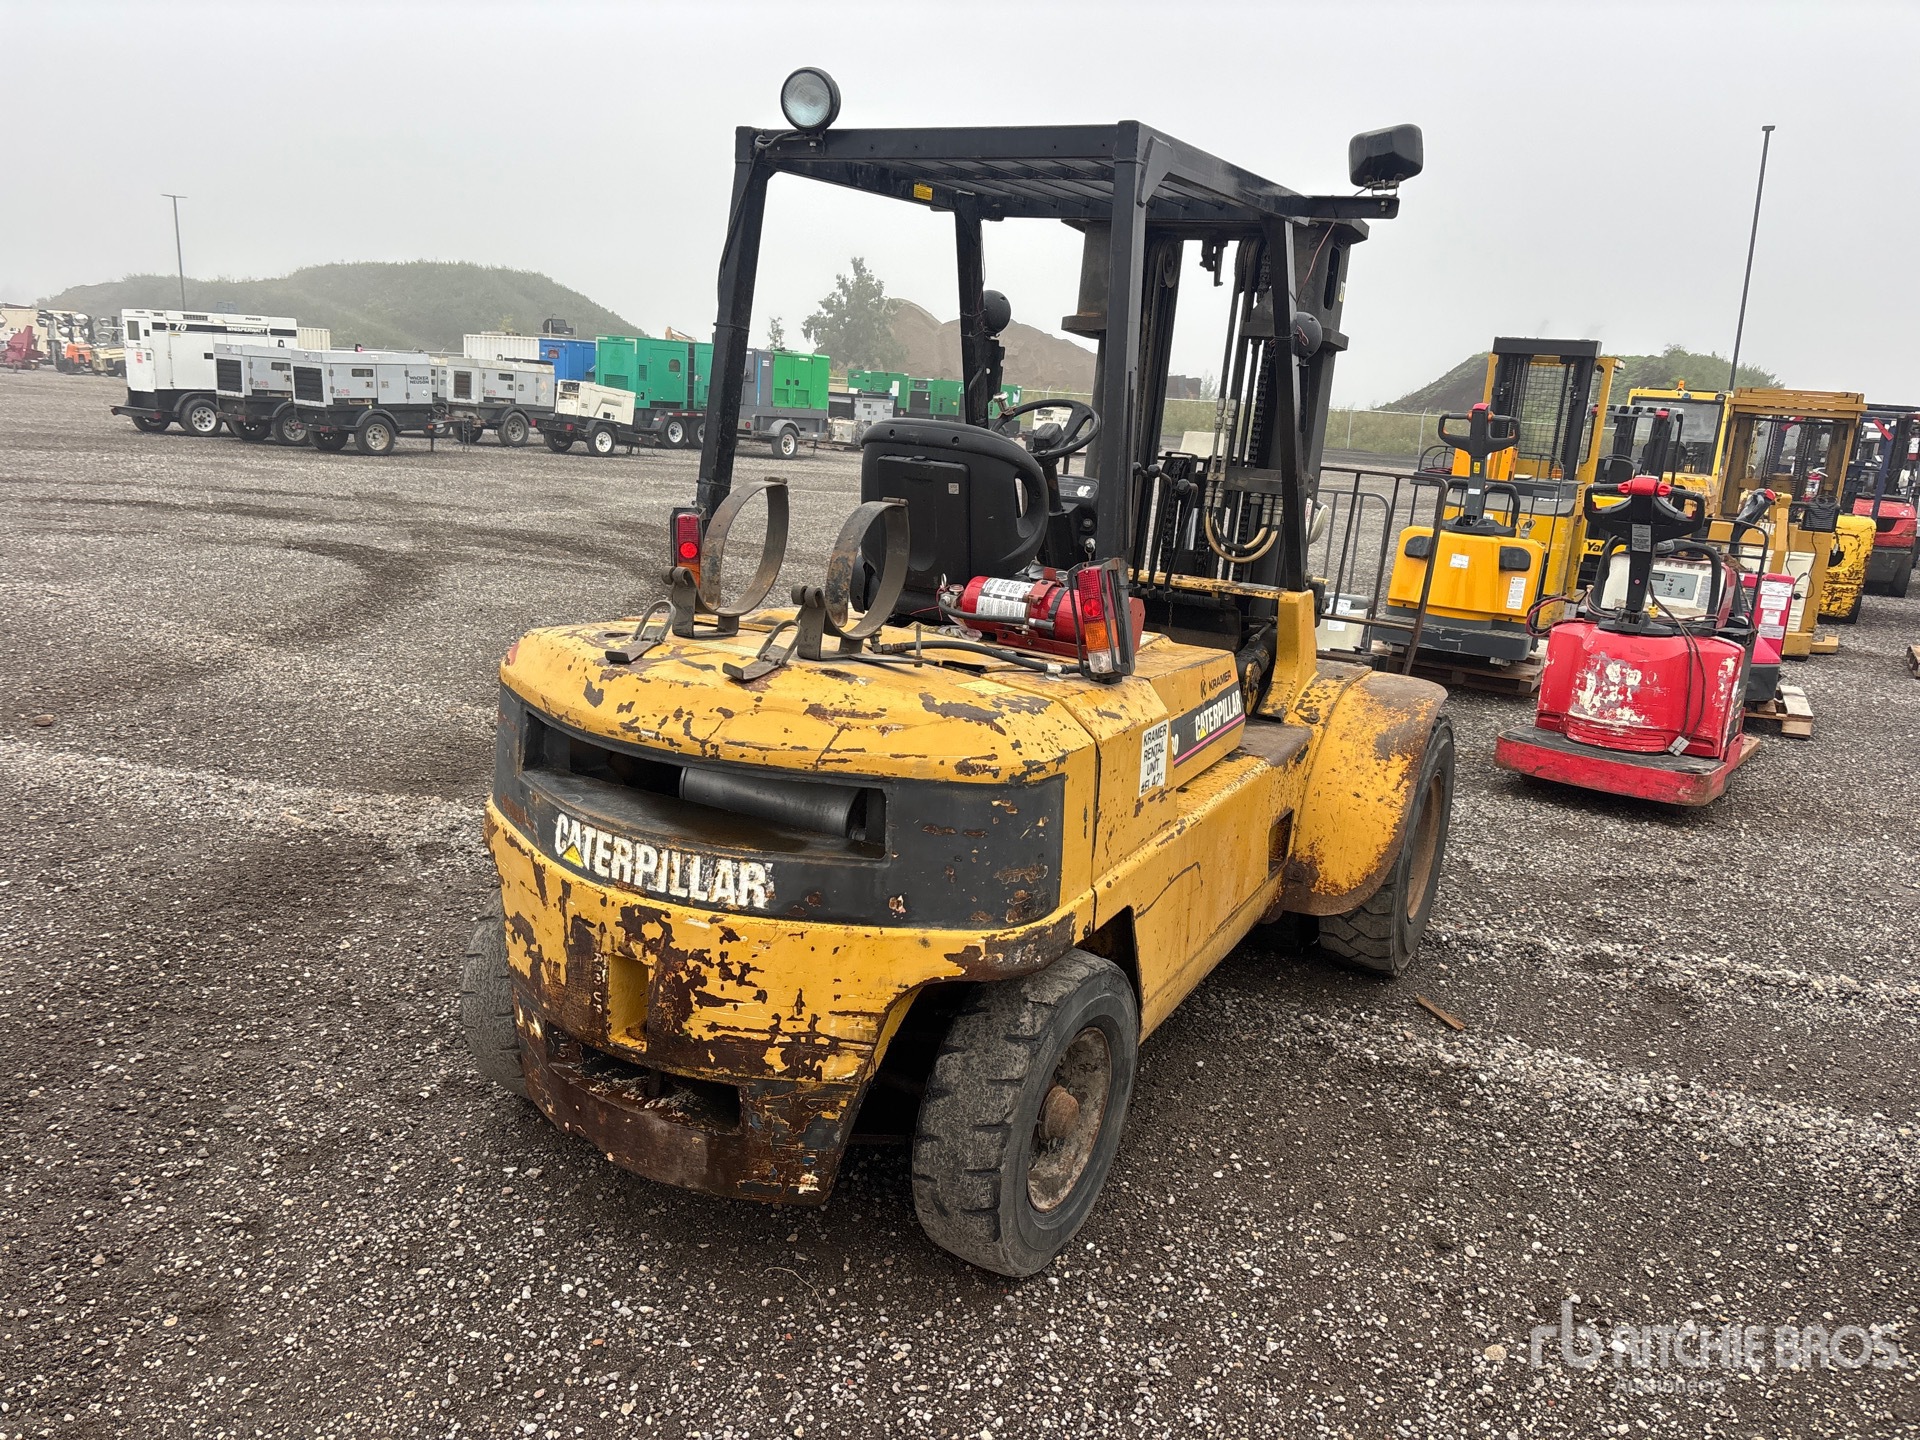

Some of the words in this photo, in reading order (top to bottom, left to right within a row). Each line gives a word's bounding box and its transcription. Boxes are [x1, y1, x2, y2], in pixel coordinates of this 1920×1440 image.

[174, 323, 187, 331] 70
[1587, 541, 1605, 552] Yal
[1208, 670, 1232, 691] KRAMER
[1195, 690, 1241, 741] CATERPILLAR
[1143, 723, 1168, 747] KRAMER
[1143, 739, 1165, 763] RENTAL
[1146, 757, 1160, 776] UNIT
[554, 812, 770, 909] CATERPILLAR
